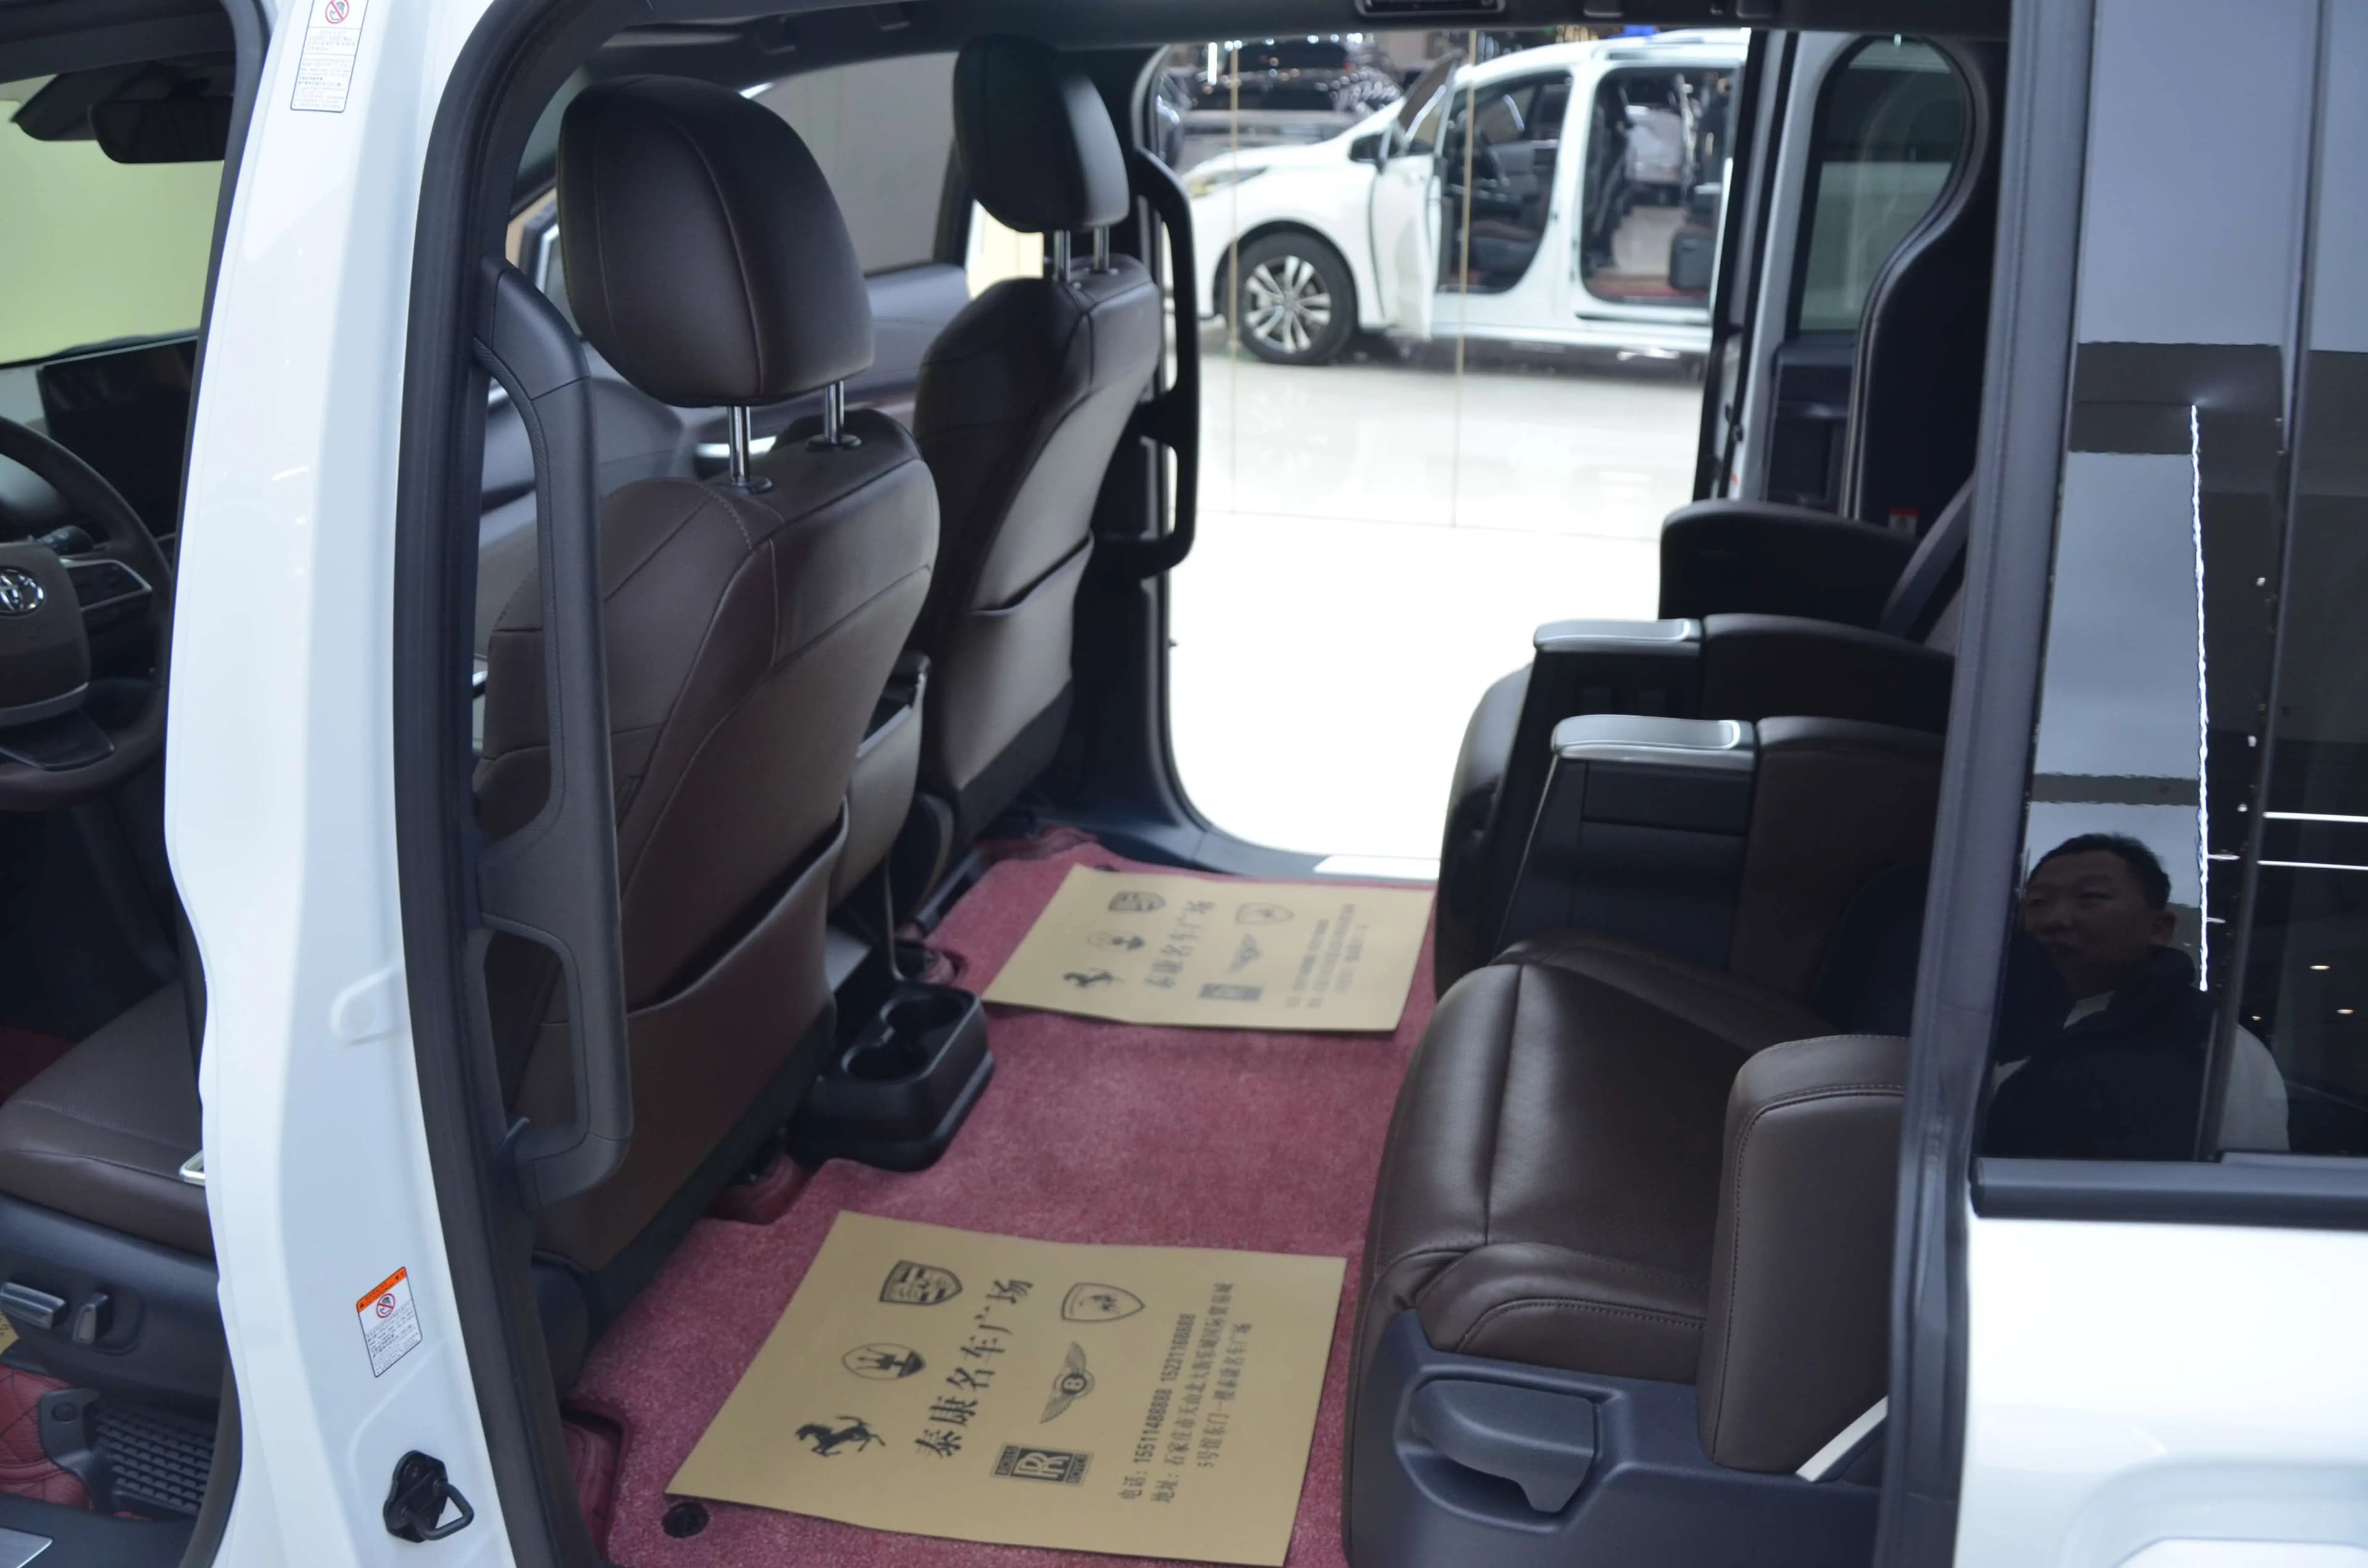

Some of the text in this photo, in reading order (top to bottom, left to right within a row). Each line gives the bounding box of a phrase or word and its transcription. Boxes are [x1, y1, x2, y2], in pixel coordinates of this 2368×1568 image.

[915, 1279, 1034, 1459] 泰康名车广场
